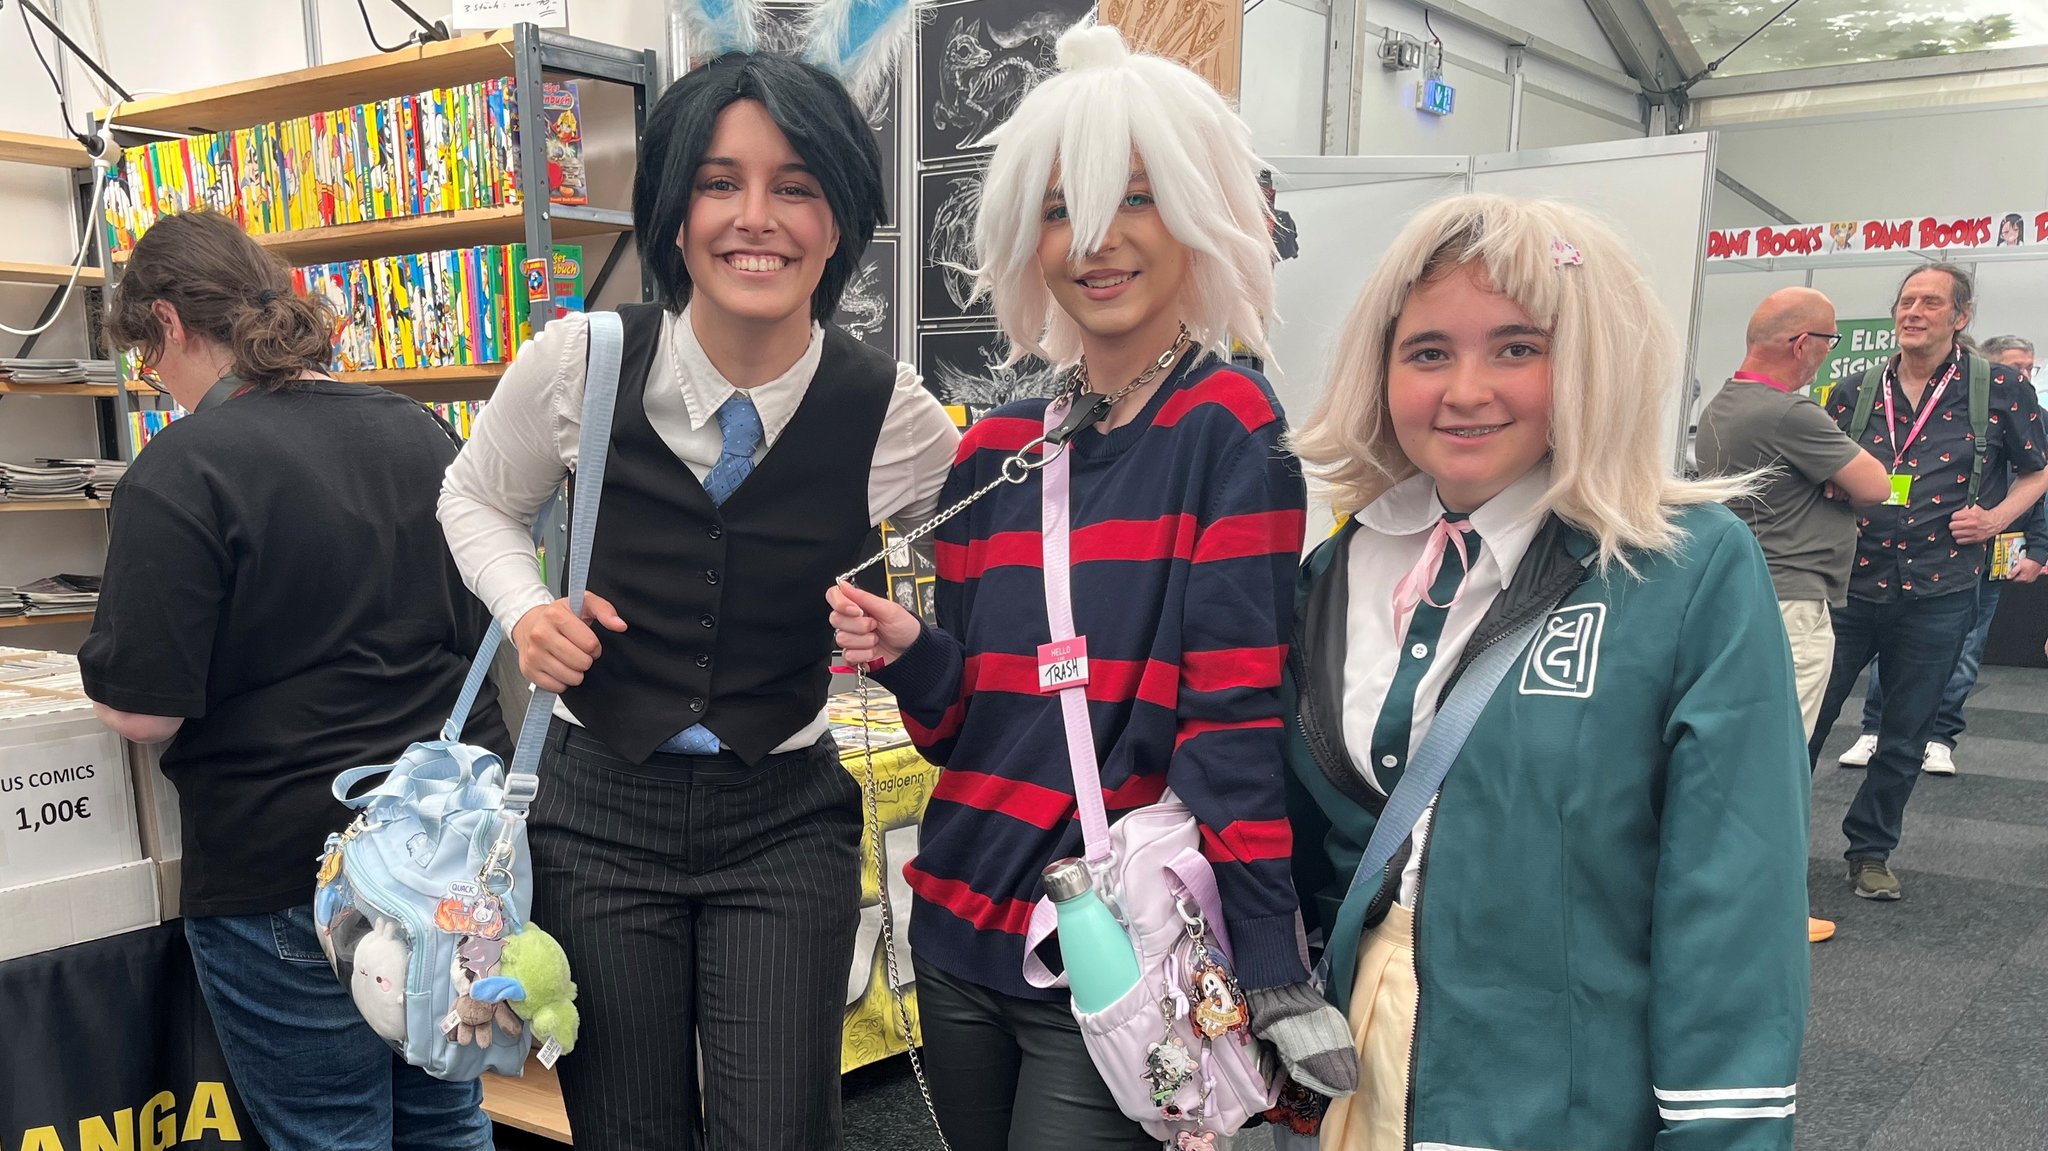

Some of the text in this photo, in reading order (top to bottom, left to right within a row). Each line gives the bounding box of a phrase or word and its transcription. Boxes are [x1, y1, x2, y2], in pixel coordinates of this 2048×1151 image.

[1756, 225, 1823, 257] BOOKS
[1918, 216, 1992, 249] BOOKS
[1050, 645, 1071, 657] HELLO
[1045, 657, 1079, 686] TRASH
[1, 764, 95, 792] US COMICS
[15, 796, 91, 832] 1,00€
[451, 883, 475, 894] QUACK
[0, 1081, 242, 1151] ANGA
